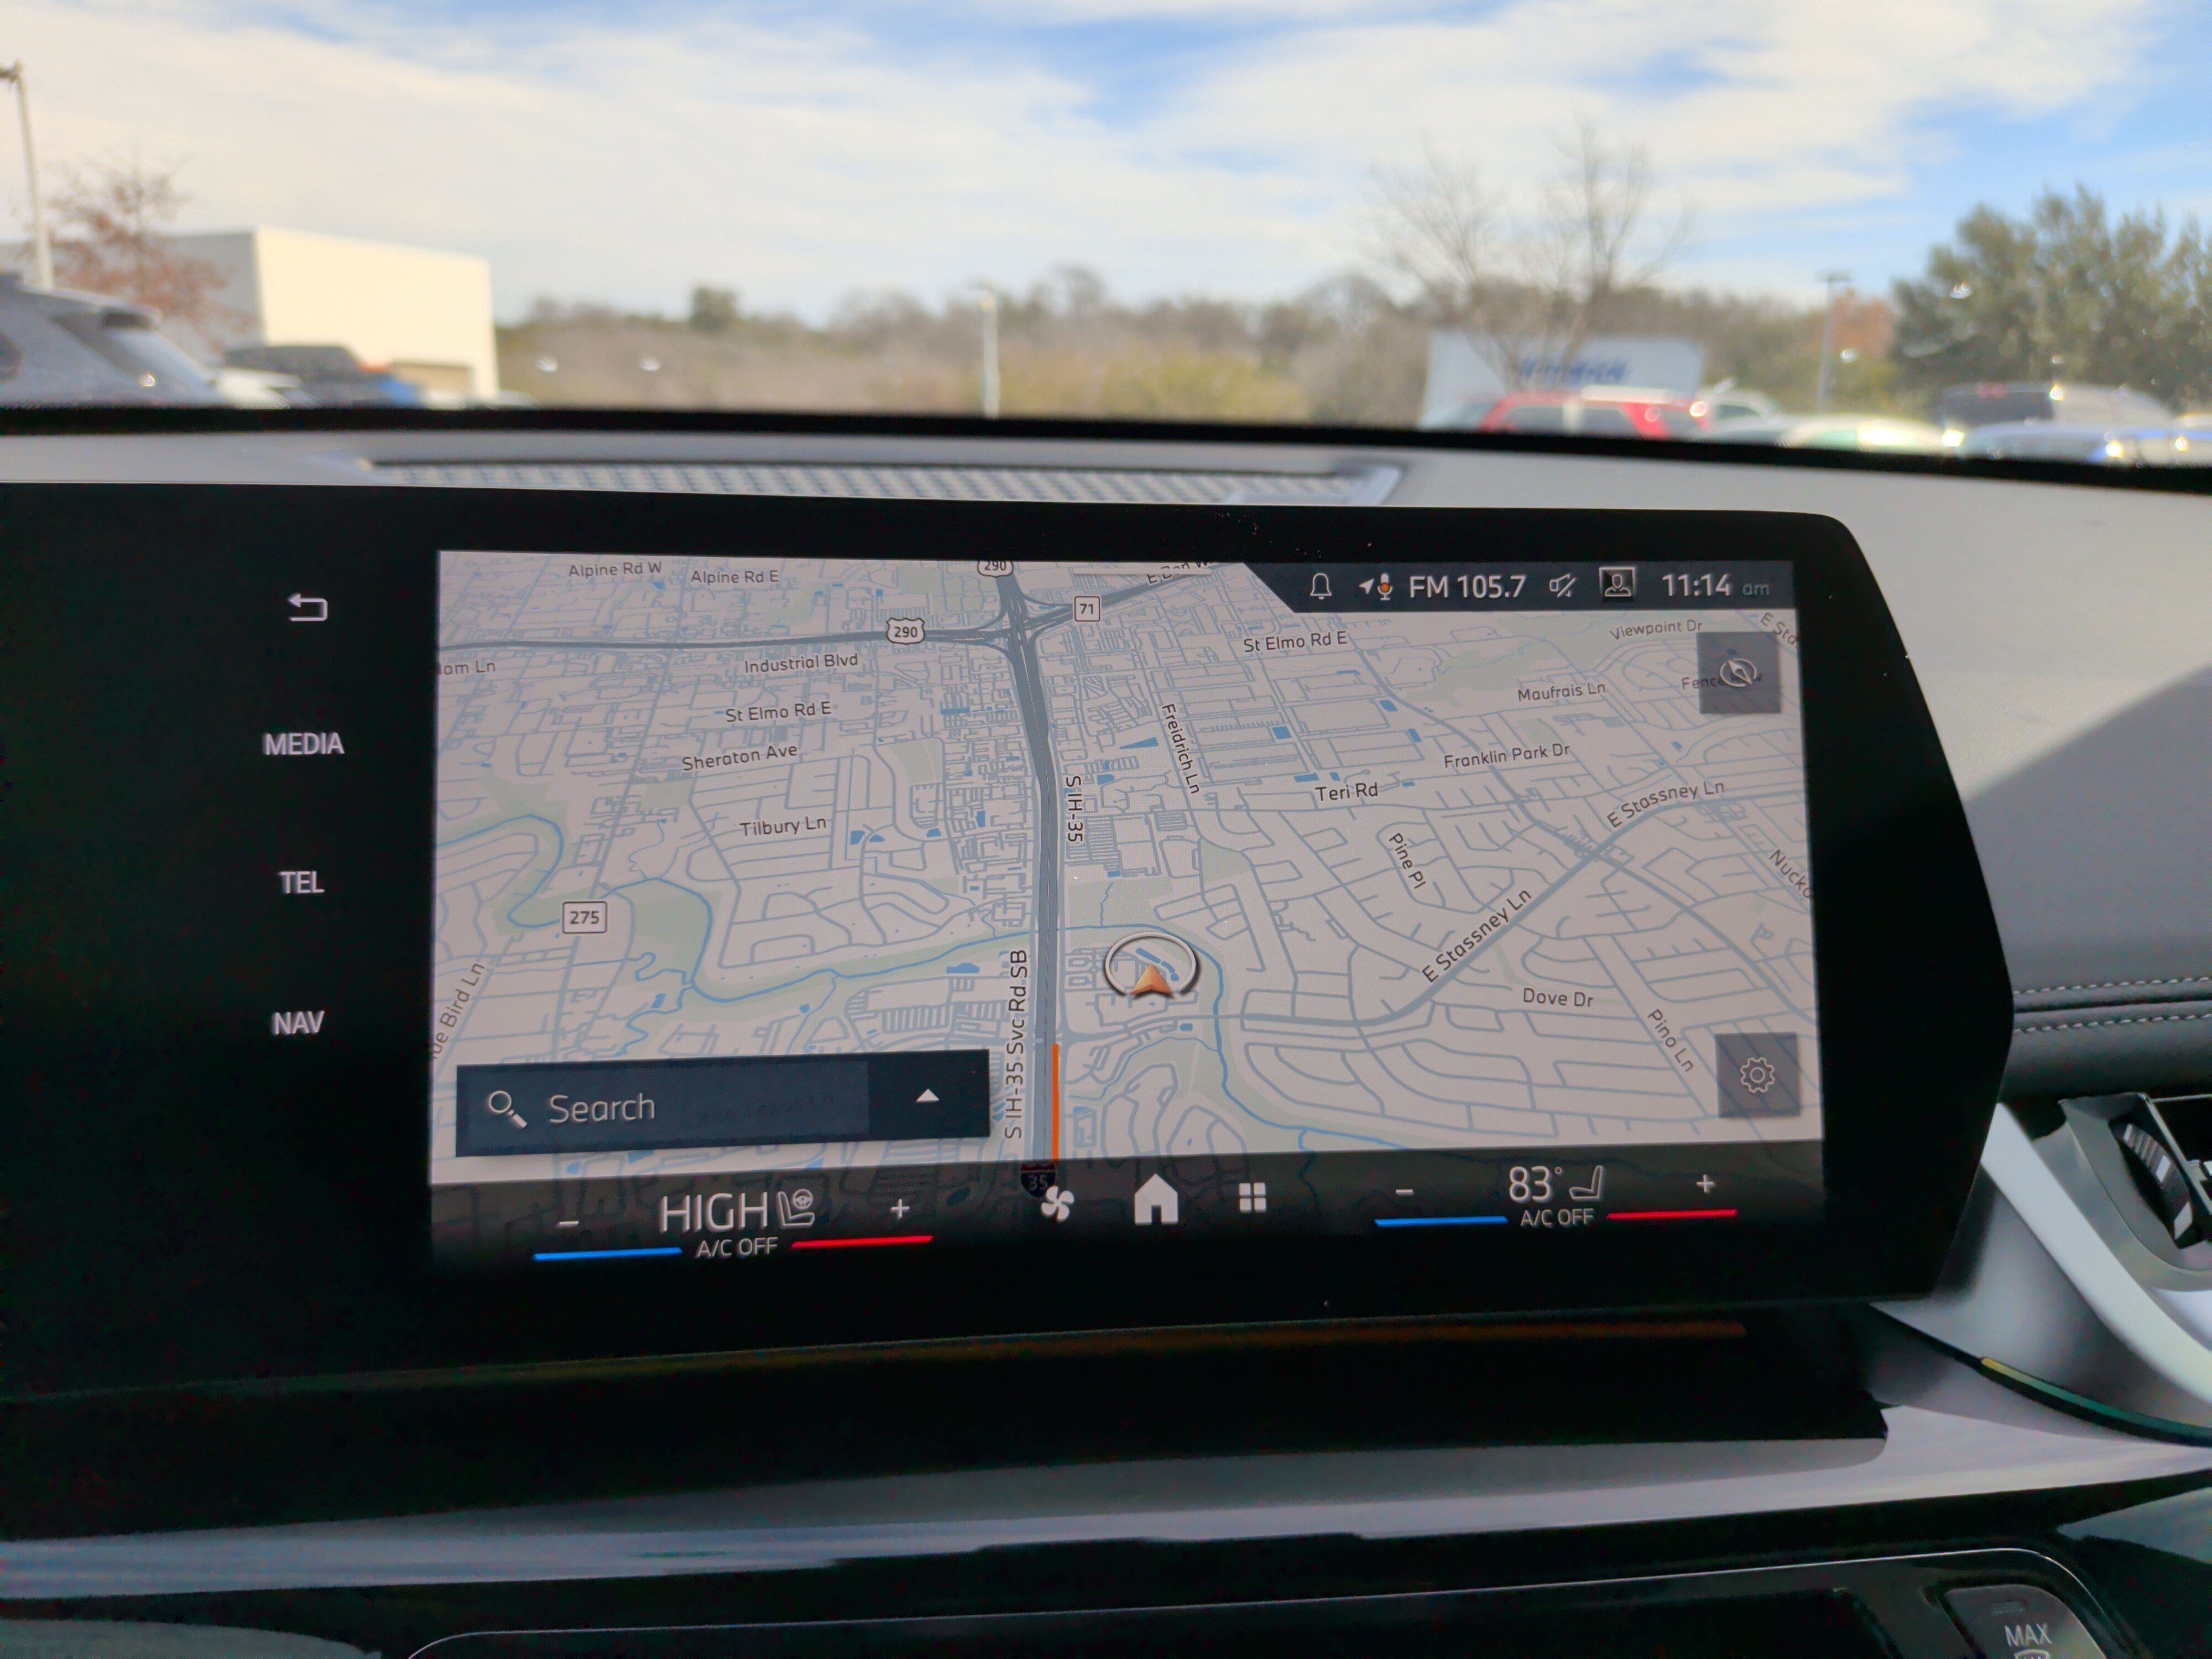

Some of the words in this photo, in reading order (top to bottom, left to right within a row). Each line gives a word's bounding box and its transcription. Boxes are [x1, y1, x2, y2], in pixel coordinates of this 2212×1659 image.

[569, 565, 618, 579] Alpine
[623, 562, 643, 575] Rd
[648, 561, 662, 573] W
[985, 560, 1006, 571] 290
[691, 570, 739, 586] Alpine
[745, 570, 764, 583] Rd
[770, 570, 779, 582] E
[1410, 575, 1448, 598] FM
[1457, 575, 1526, 598] 105.7
[1662, 573, 1731, 597] 11:14
[1742, 582, 1769, 596] am
[1080, 603, 1093, 614] 71
[1760, 612, 1775, 627] E
[894, 626, 917, 638] 290
[1609, 622, 1682, 640] Viewpoint
[1687, 619, 1703, 632] Dr
[1244, 638, 1260, 653] St
[1265, 637, 1305, 650] Elmo
[1311, 632, 1331, 646] Rd
[1337, 630, 1347, 644] E
[441, 664, 469, 675] am
[476, 660, 495, 673] Ln
[744, 656, 819, 674] Industrial
[824, 653, 858, 667] Blvd
[1517, 686, 1583, 701] Maufrais
[1587, 682, 1605, 695] Ln
[726, 708, 743, 722] St
[748, 707, 789, 721] Elmo
[795, 703, 816, 716] Rd
[821, 701, 831, 714] E
[264, 732, 345, 755] MEDIA
[1162, 703, 1193, 770] Freidrich
[1186, 774, 1199, 794] Ln
[682, 751, 760, 771] Sheraton
[766, 745, 797, 759] Ave
[1444, 751, 1507, 768] Franklin
[1512, 745, 1548, 760] Park
[1552, 743, 1569, 757] Dr
[1066, 775, 1081, 787] S
[1315, 784, 1350, 801] Teri
[1355, 782, 1378, 797] Rd
[1607, 812, 1622, 828] E
[1621, 786, 1698, 818] Stassney
[1703, 781, 1724, 795] Ln
[740, 820, 800, 839] Tilbury
[806, 816, 826, 830] Ln
[1067, 794, 1083, 842] IH-35
[1389, 833, 1412, 869] Pine
[1408, 870, 1426, 889] Pl
[279, 870, 325, 894] TEL
[570, 910, 599, 925] 275
[1422, 964, 1439, 983] E
[1436, 907, 1511, 972] Stassney
[1507, 890, 1531, 911] Ln
[1010, 950, 1027, 978] SB
[439, 989, 470, 1028] Bird
[461, 963, 484, 987] Ln
[1008, 986, 1026, 1011] Rd
[1523, 988, 1567, 1006] Dove
[1574, 992, 1594, 1007] Dr
[273, 1010, 325, 1035] NAV
[1006, 1018, 1025, 1055] Svc
[1647, 1009, 1676, 1048] Pino
[1674, 1048, 1693, 1072] Ln
[1005, 1062, 1023, 1118] IH-35
[549, 1093, 655, 1123] Search
[1004, 1126, 1022, 1139] S
[1028, 1175, 1048, 1192] 35
[661, 1191, 768, 1232] HIGH
[1520, 1209, 1552, 1227] A/C
[1557, 1208, 1594, 1226] OFF
[696, 1239, 732, 1258] A/C
[738, 1237, 778, 1256] OFF
[2004, 1623, 2052, 1647] MAX
